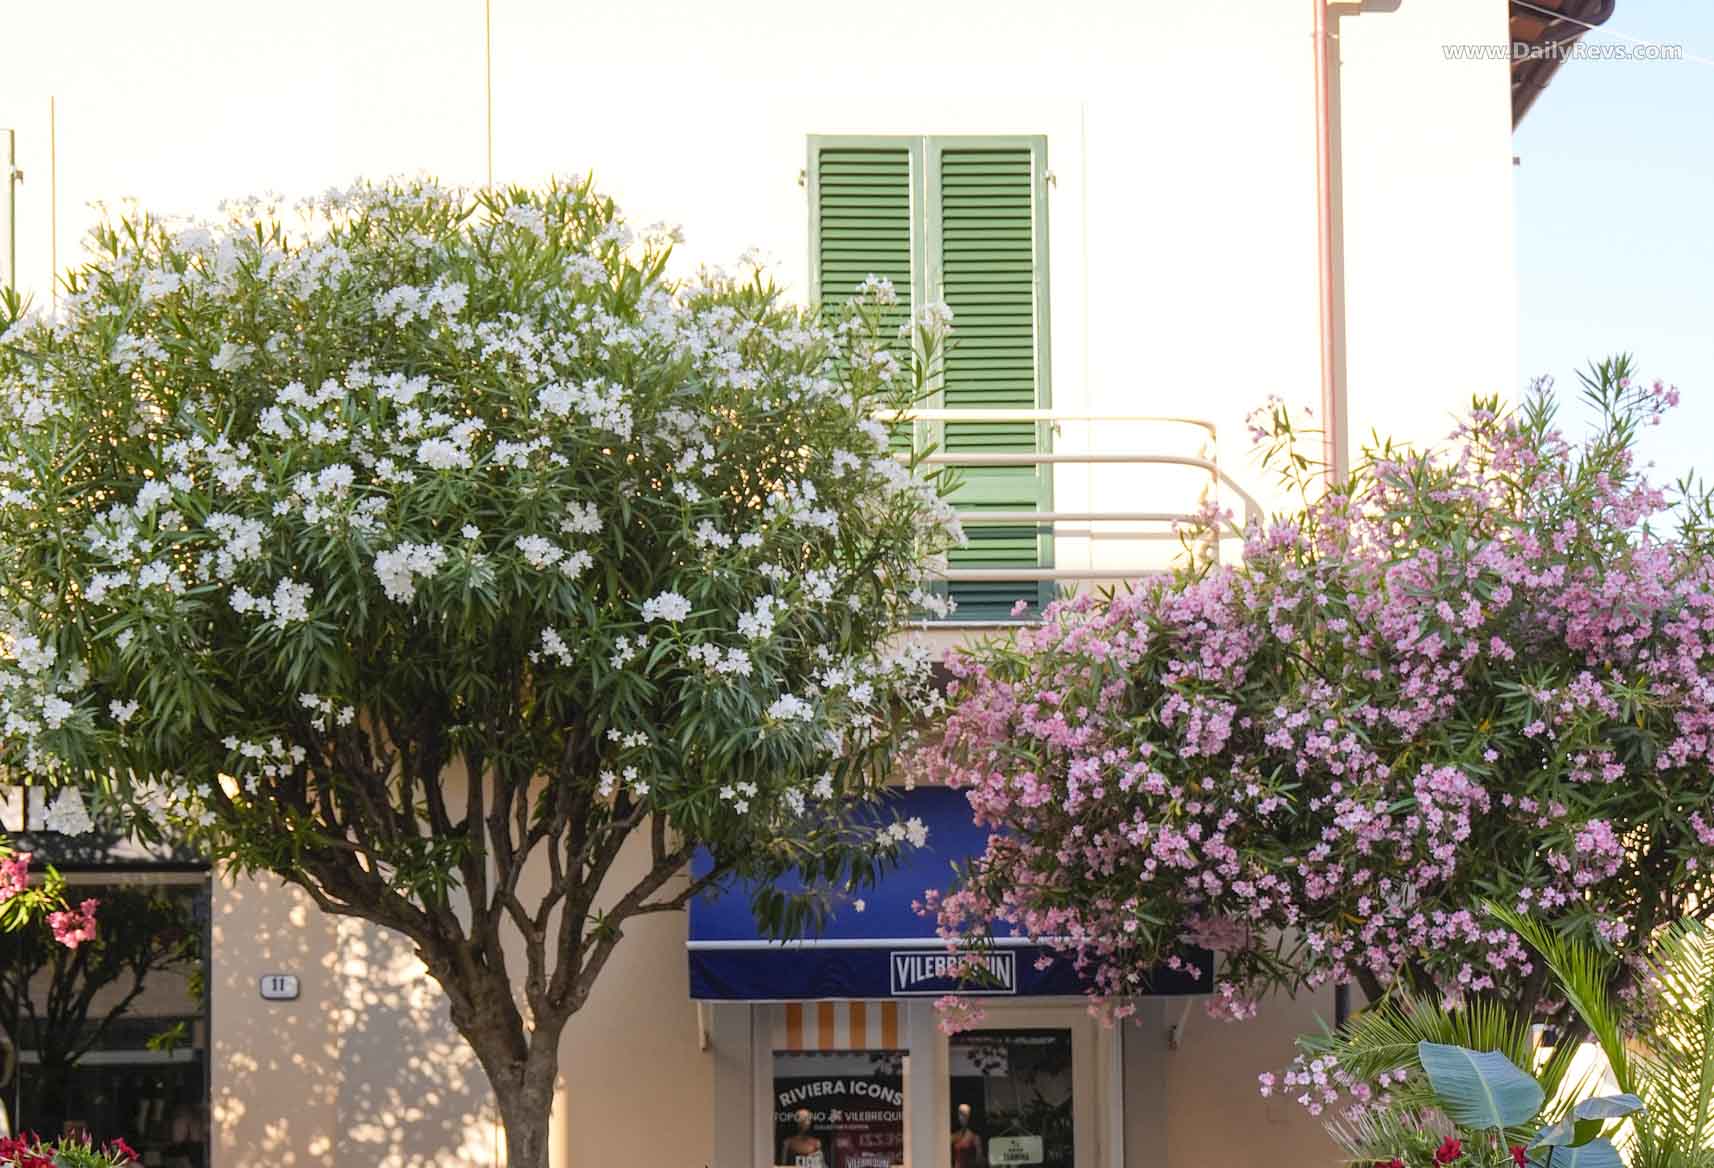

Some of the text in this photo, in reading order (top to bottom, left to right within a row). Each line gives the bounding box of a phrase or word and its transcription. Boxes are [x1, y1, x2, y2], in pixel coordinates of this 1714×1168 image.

[272, 976, 285, 992] 11
[895, 955, 1011, 990] VILEBRIN
[779, 1079, 903, 1107] RIVIERA ICONS
